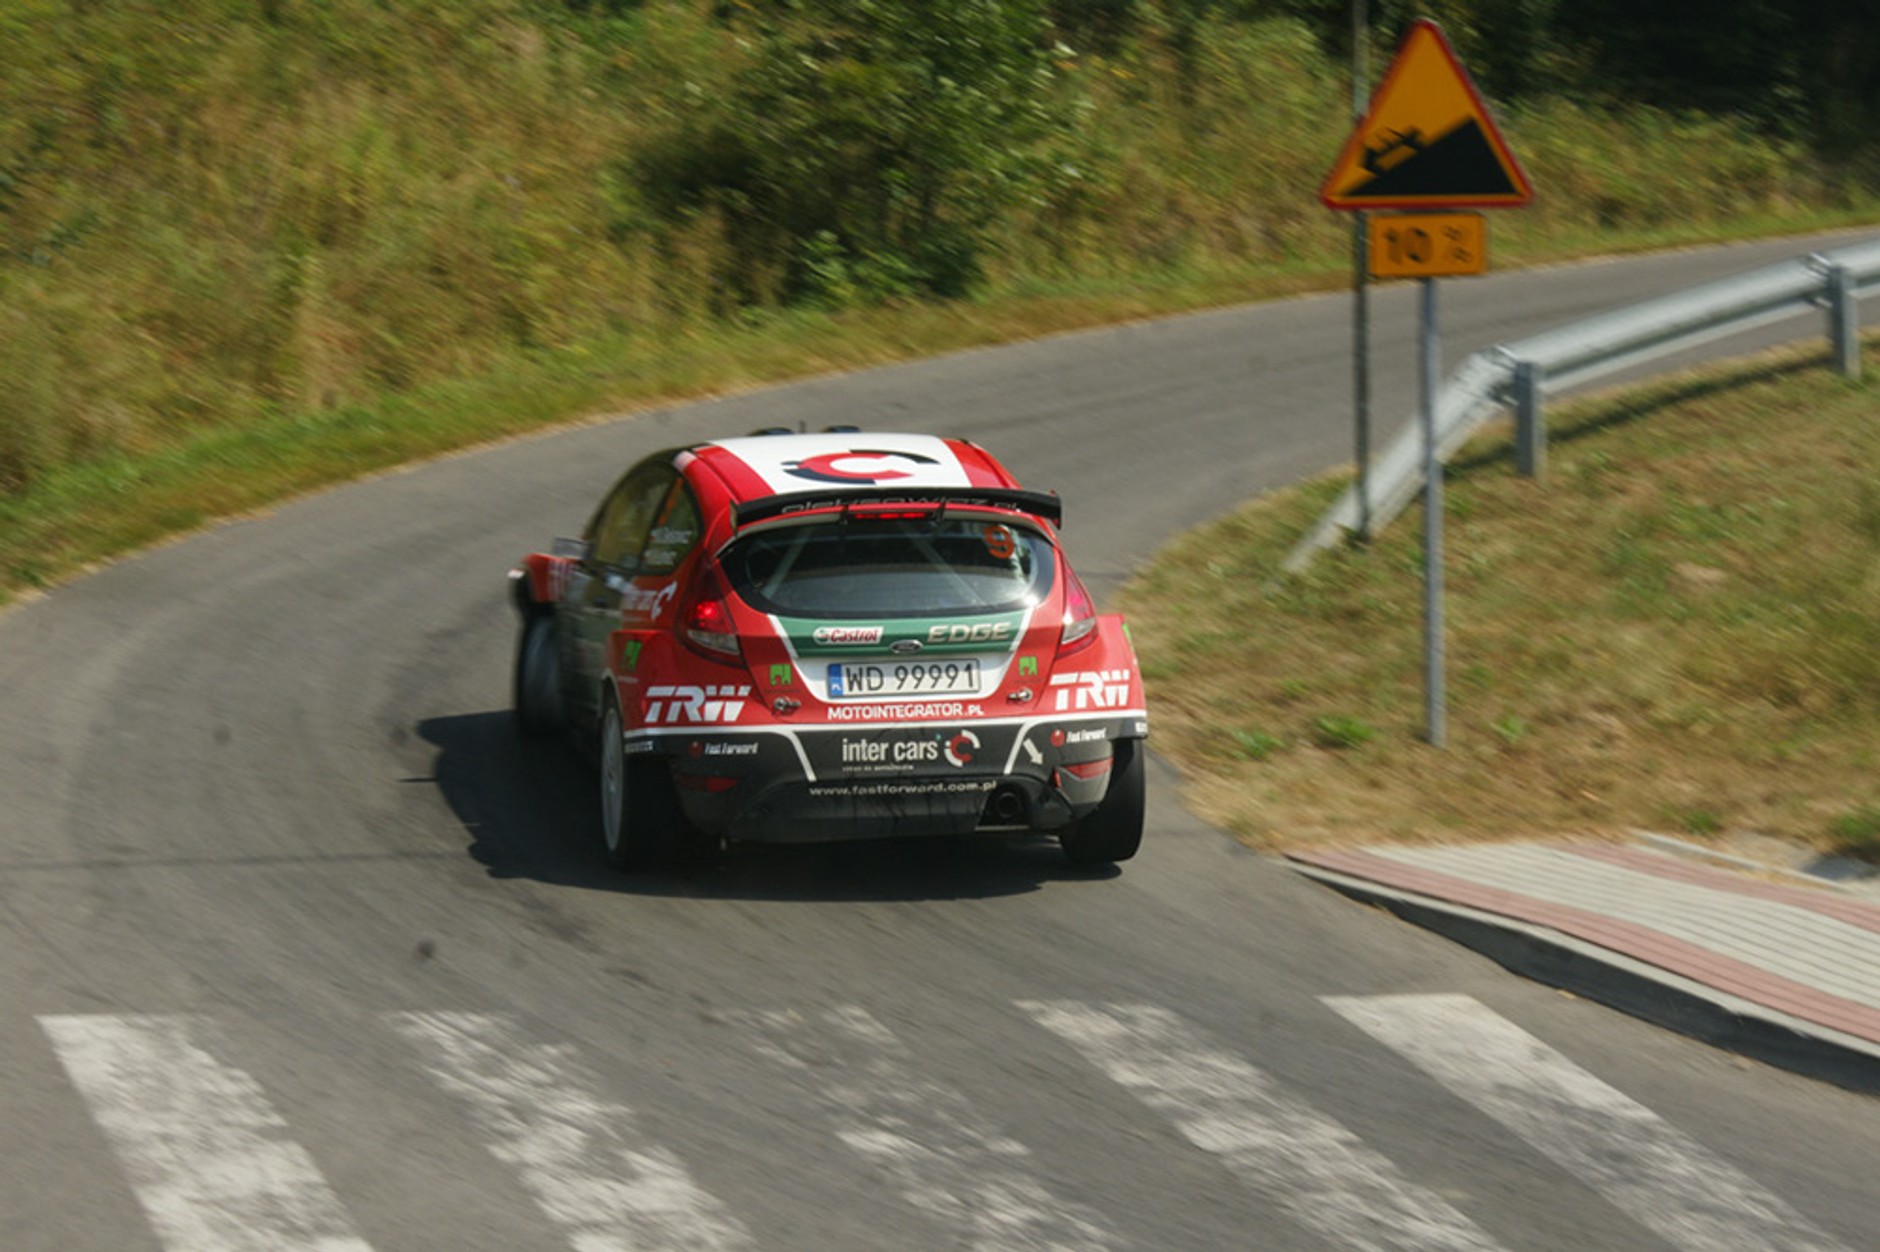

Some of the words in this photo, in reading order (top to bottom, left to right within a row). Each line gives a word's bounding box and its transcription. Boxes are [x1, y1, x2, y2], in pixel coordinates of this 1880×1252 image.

[1383, 226, 1433, 264] 10
[984, 525, 1014, 559] 9
[831, 628, 879, 642] Castrol
[927, 622, 1011, 642] EDGE
[846, 665, 885, 691] WD
[894, 662, 974, 690] 99991
[1049, 669, 1130, 711] TRW
[644, 685, 752, 723] TRW
[842, 738, 886, 762] inter
[893, 737, 939, 761] cars
[809, 780, 998, 796] www.fastforward.com.pl
